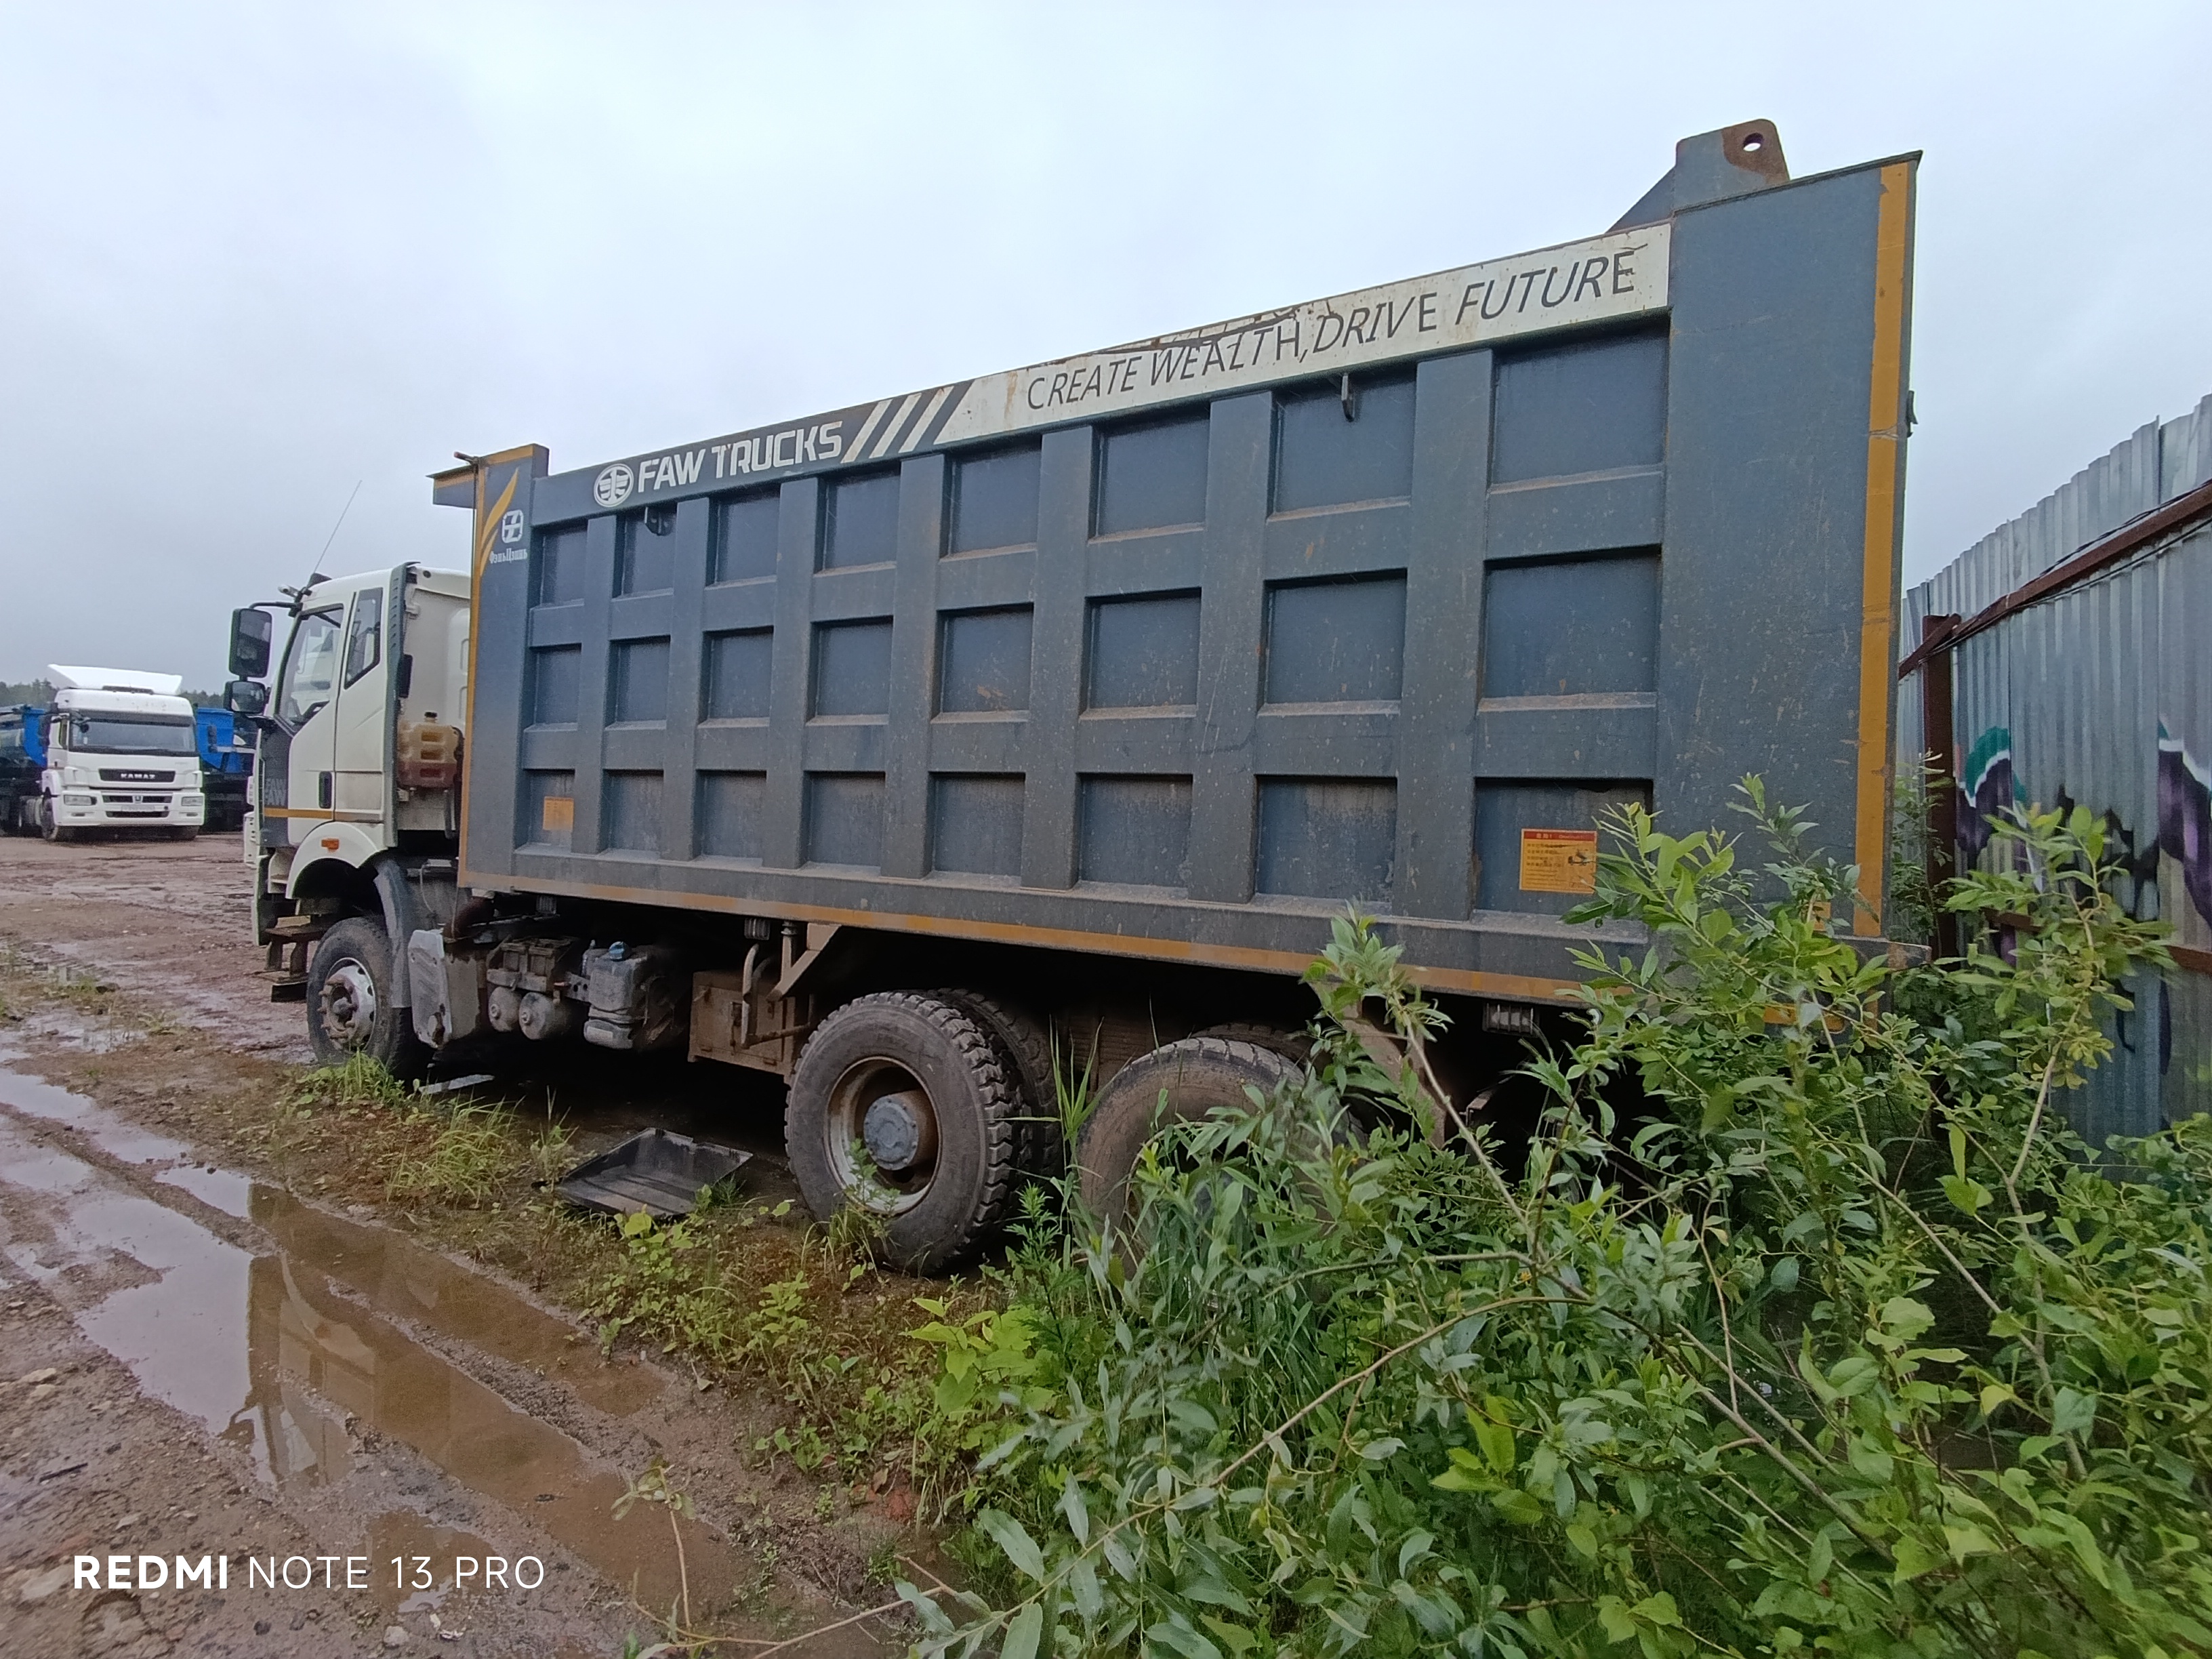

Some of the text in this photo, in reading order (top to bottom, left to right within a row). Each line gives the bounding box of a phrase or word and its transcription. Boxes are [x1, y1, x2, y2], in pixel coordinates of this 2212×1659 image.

[1027, 356, 1142, 409] CREATE
[1455, 251, 1635, 325] FUTURE
[638, 421, 843, 493] FAW TRUCKS
